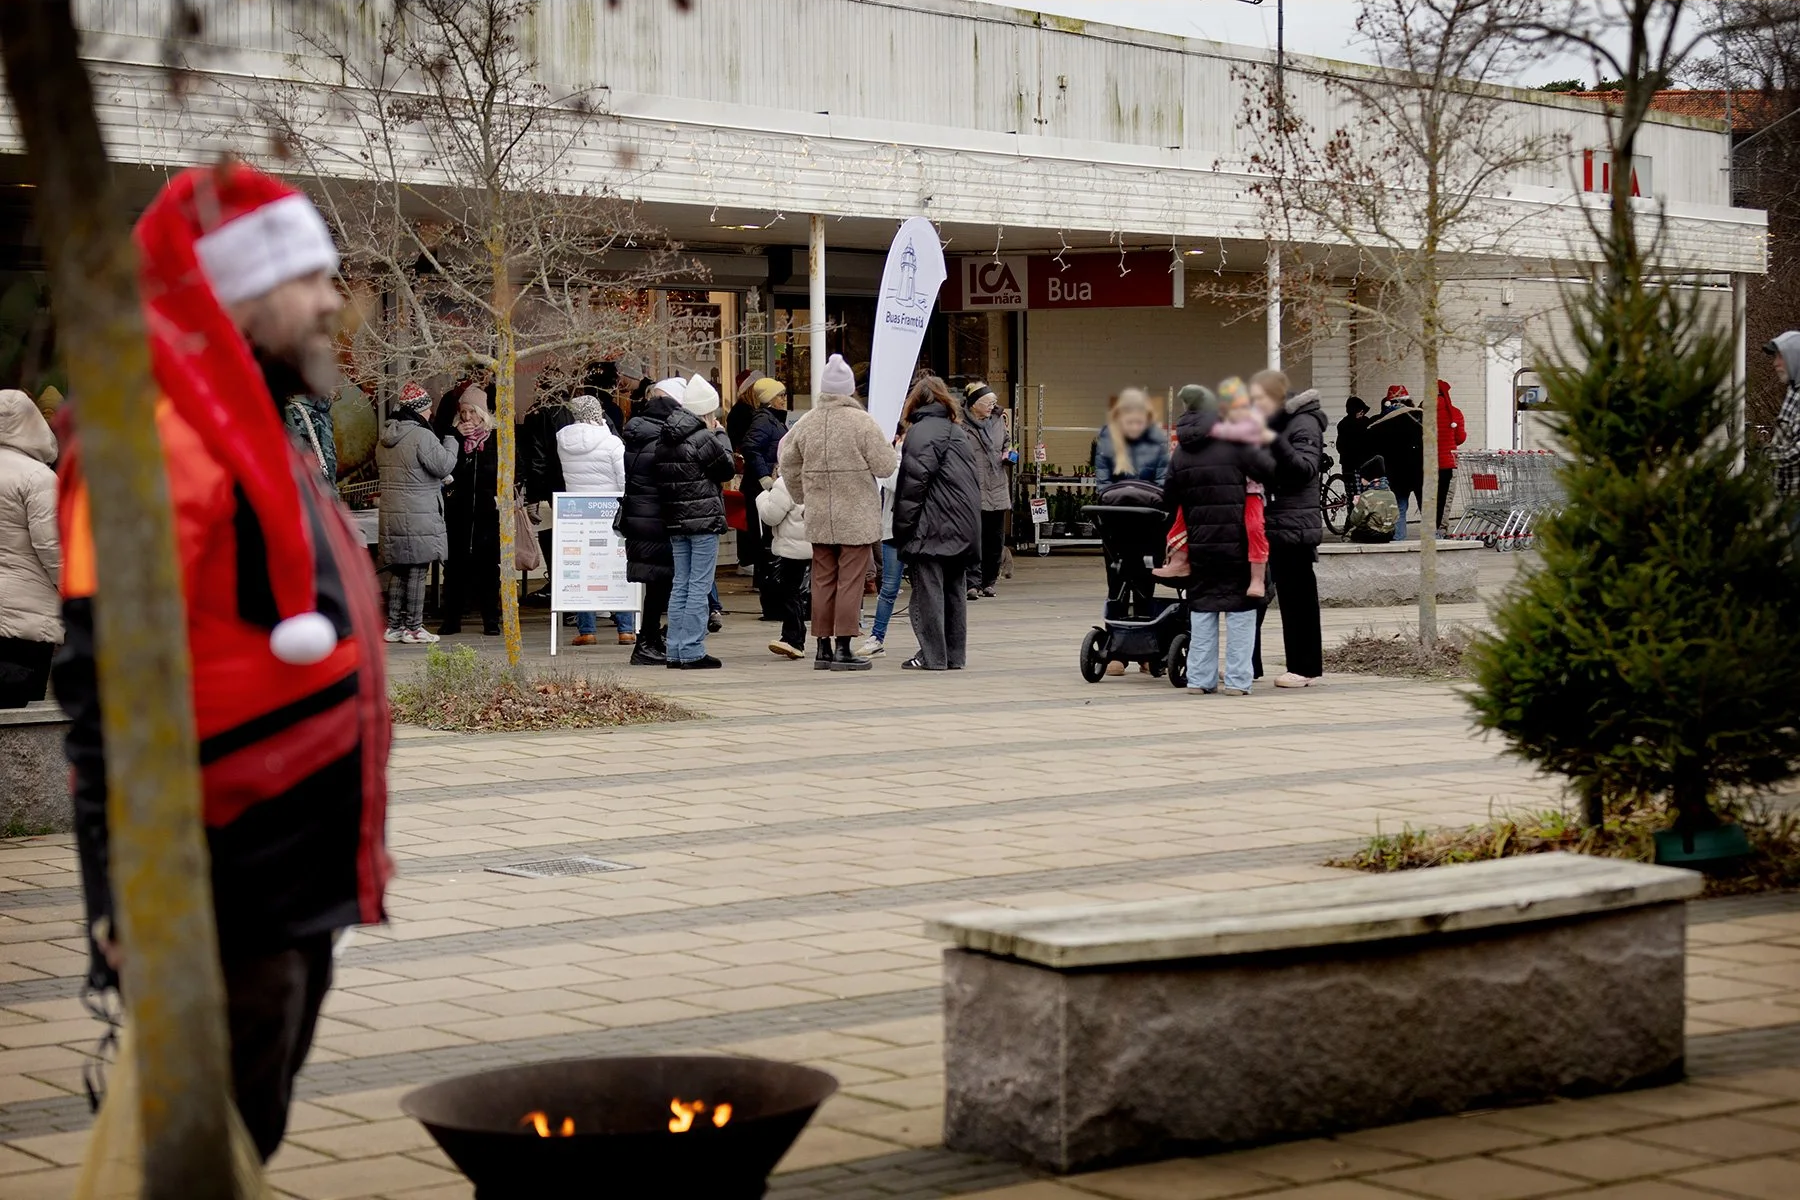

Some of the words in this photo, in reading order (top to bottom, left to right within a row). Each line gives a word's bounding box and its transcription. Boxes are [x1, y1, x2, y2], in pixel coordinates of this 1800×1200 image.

[969, 262, 1022, 294] ICA
[1048, 277, 1092, 302] Bua
[994, 293, 1022, 305] nära
[588, 501, 620, 509] SPONSO
